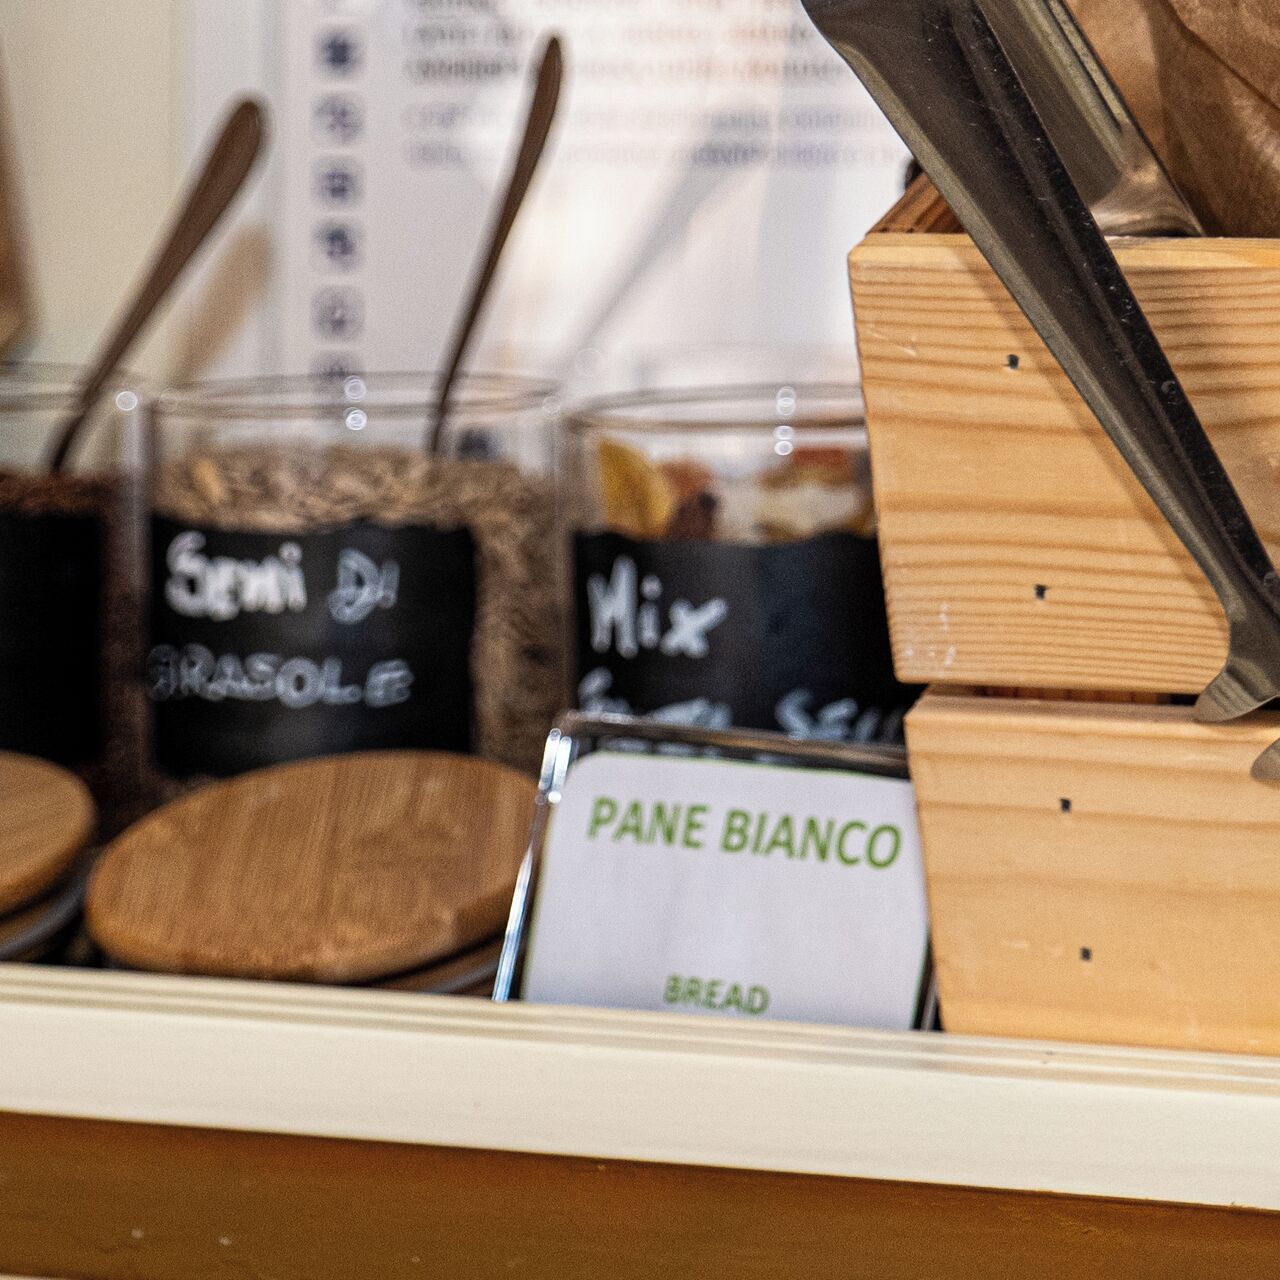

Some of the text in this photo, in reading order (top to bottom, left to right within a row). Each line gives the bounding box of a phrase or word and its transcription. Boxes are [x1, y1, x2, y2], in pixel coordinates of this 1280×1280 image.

[587, 556, 729, 658] Mix
[587, 796, 902, 869] PANE BIANCO
[664, 974, 770, 1016] BREAD
